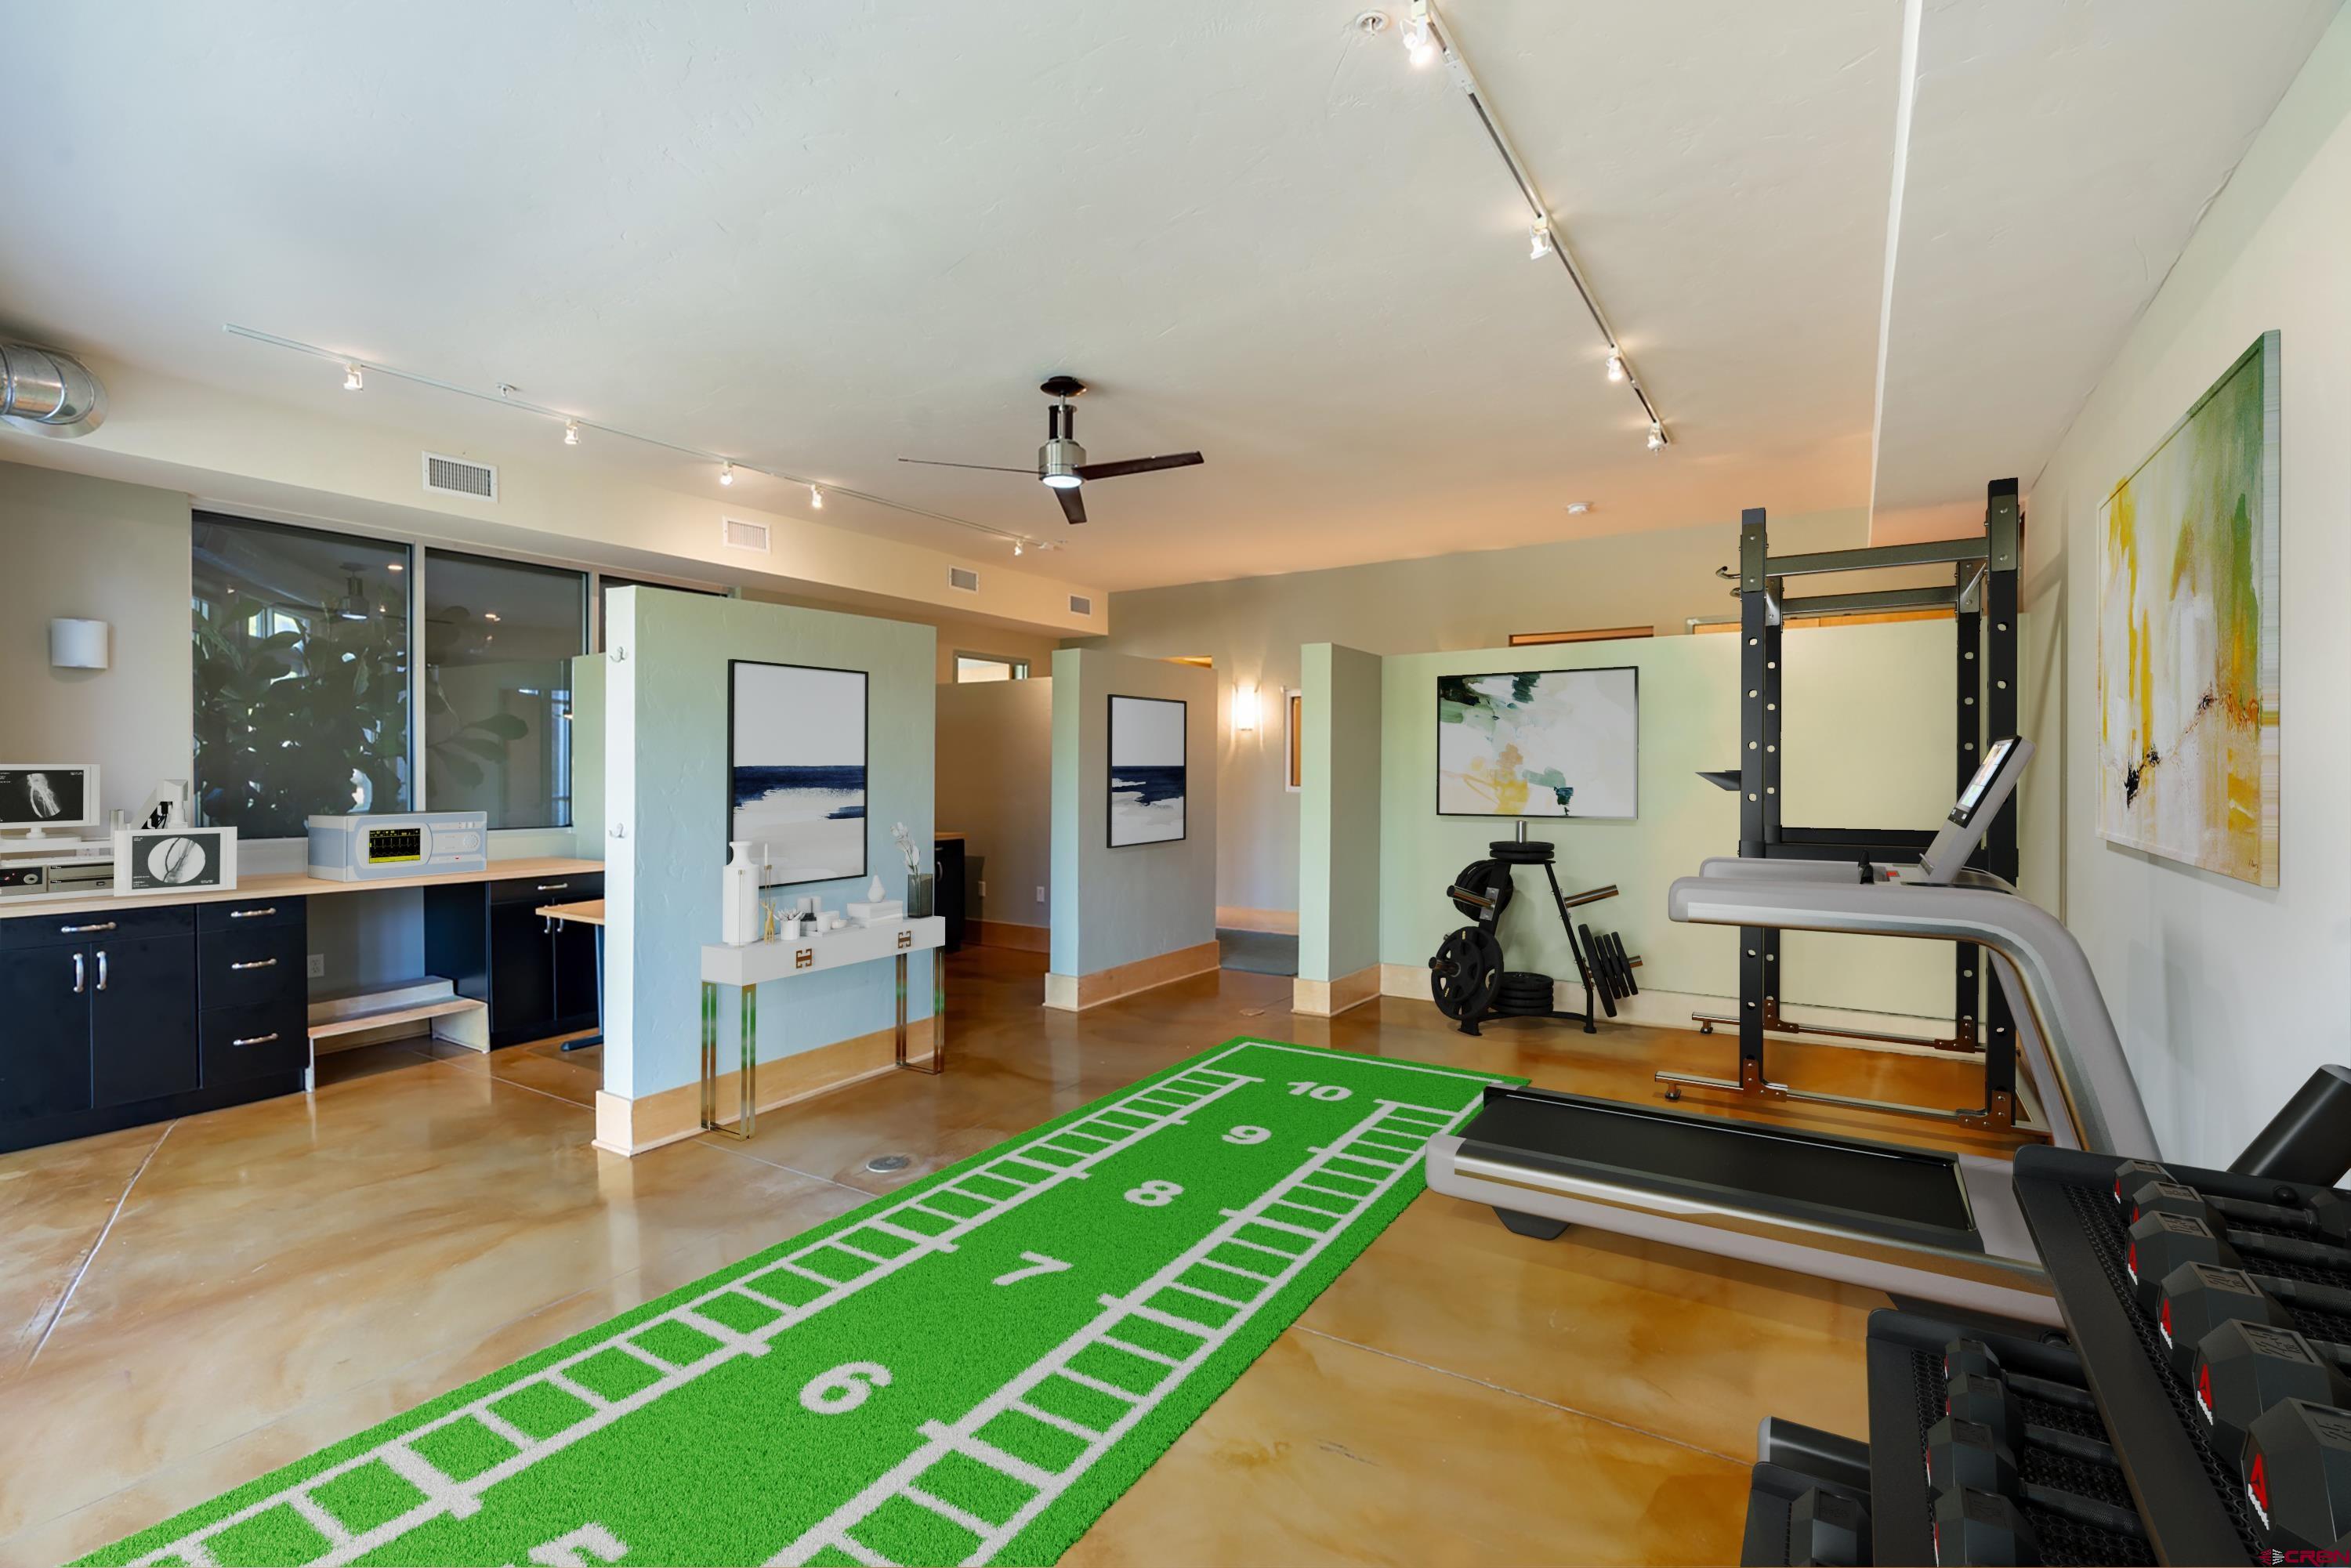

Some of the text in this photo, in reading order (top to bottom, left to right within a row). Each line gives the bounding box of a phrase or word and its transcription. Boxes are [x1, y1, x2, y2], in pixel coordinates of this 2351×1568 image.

[1287, 1081, 1353, 1101] 10
[1222, 1125, 1272, 1144] 9
[1124, 1179, 1184, 1207] 8
[992, 1251, 1074, 1285] 7
[799, 1360, 893, 1414] 6
